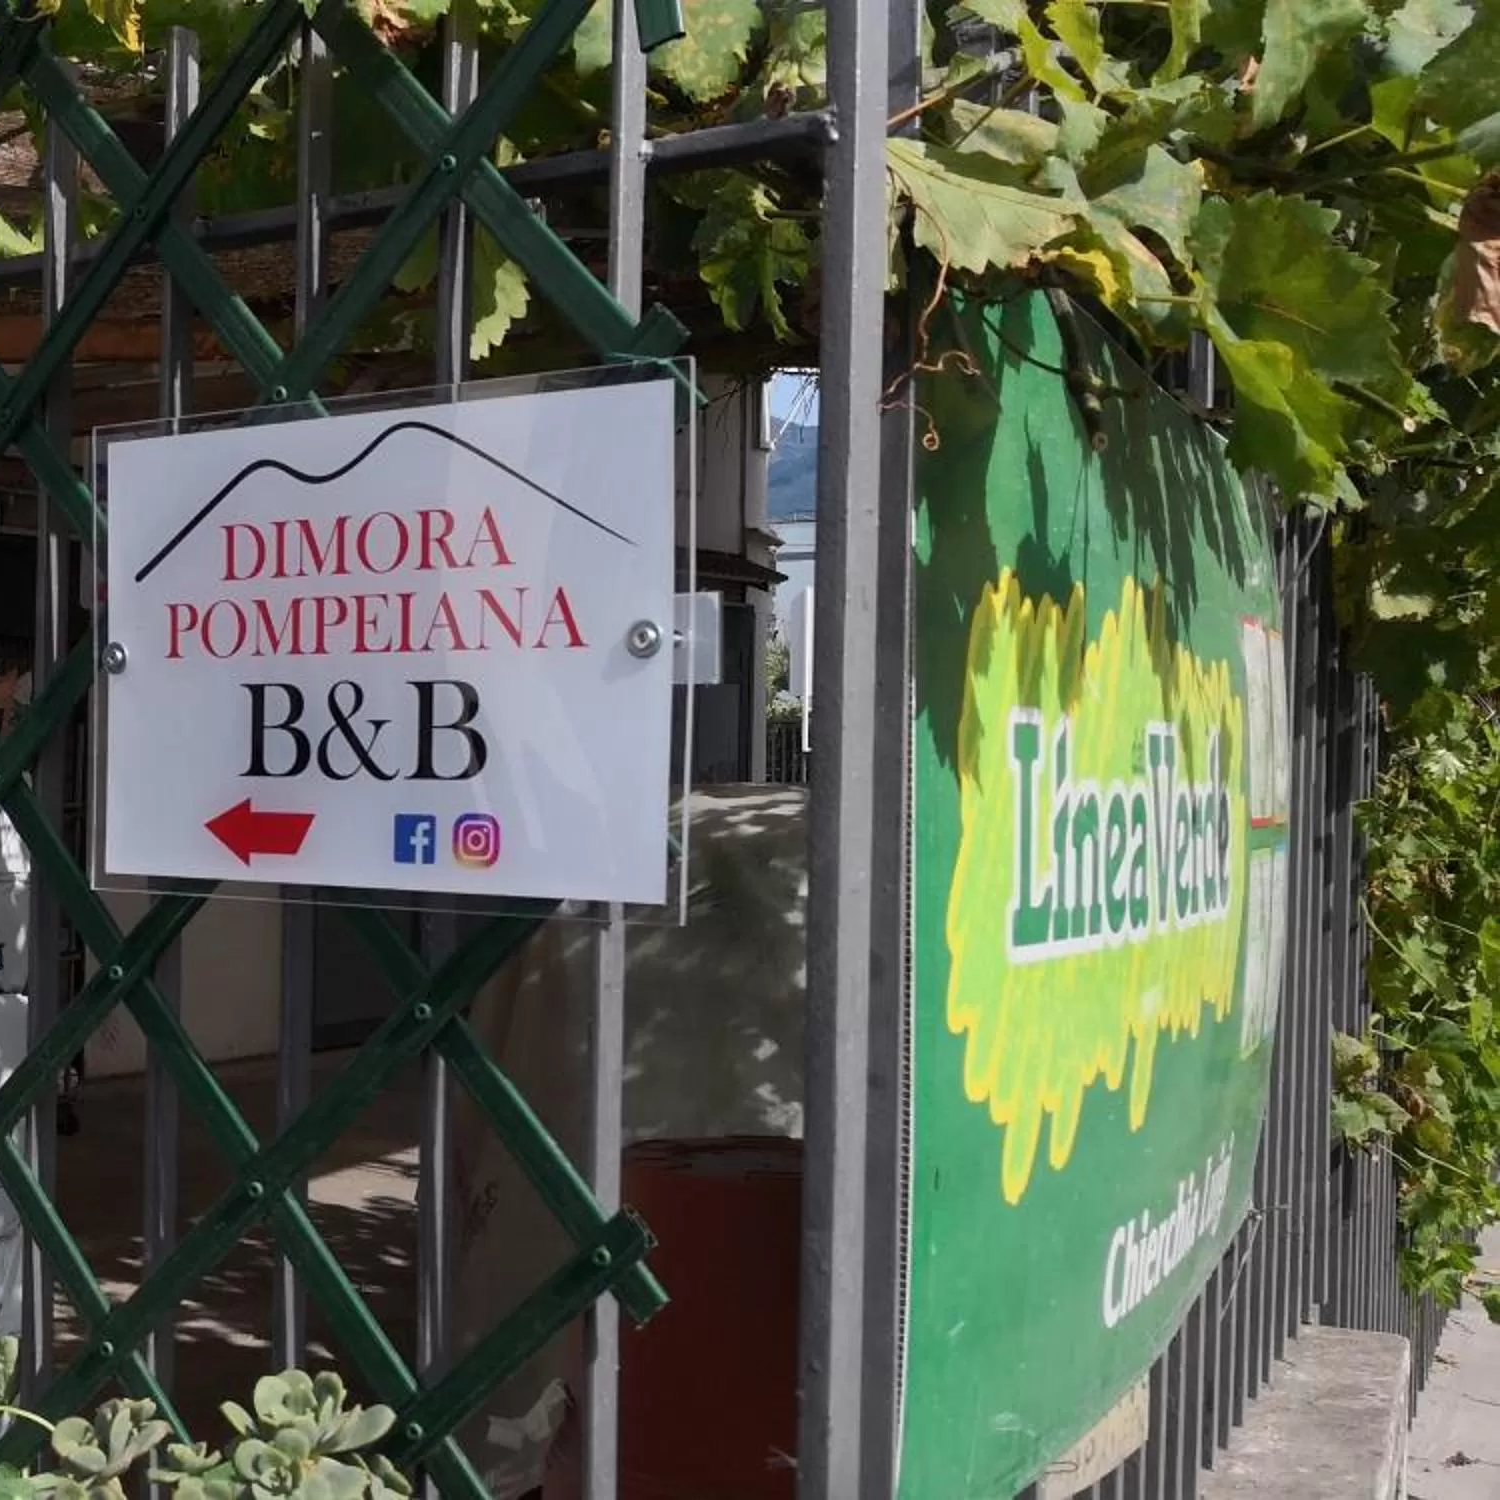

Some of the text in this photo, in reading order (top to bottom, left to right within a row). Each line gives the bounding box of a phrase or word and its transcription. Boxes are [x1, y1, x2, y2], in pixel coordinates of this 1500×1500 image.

[220, 505, 517, 582] DIMORA
[163, 585, 590, 660] POMPEIANA
[237, 678, 490, 782] B&B
